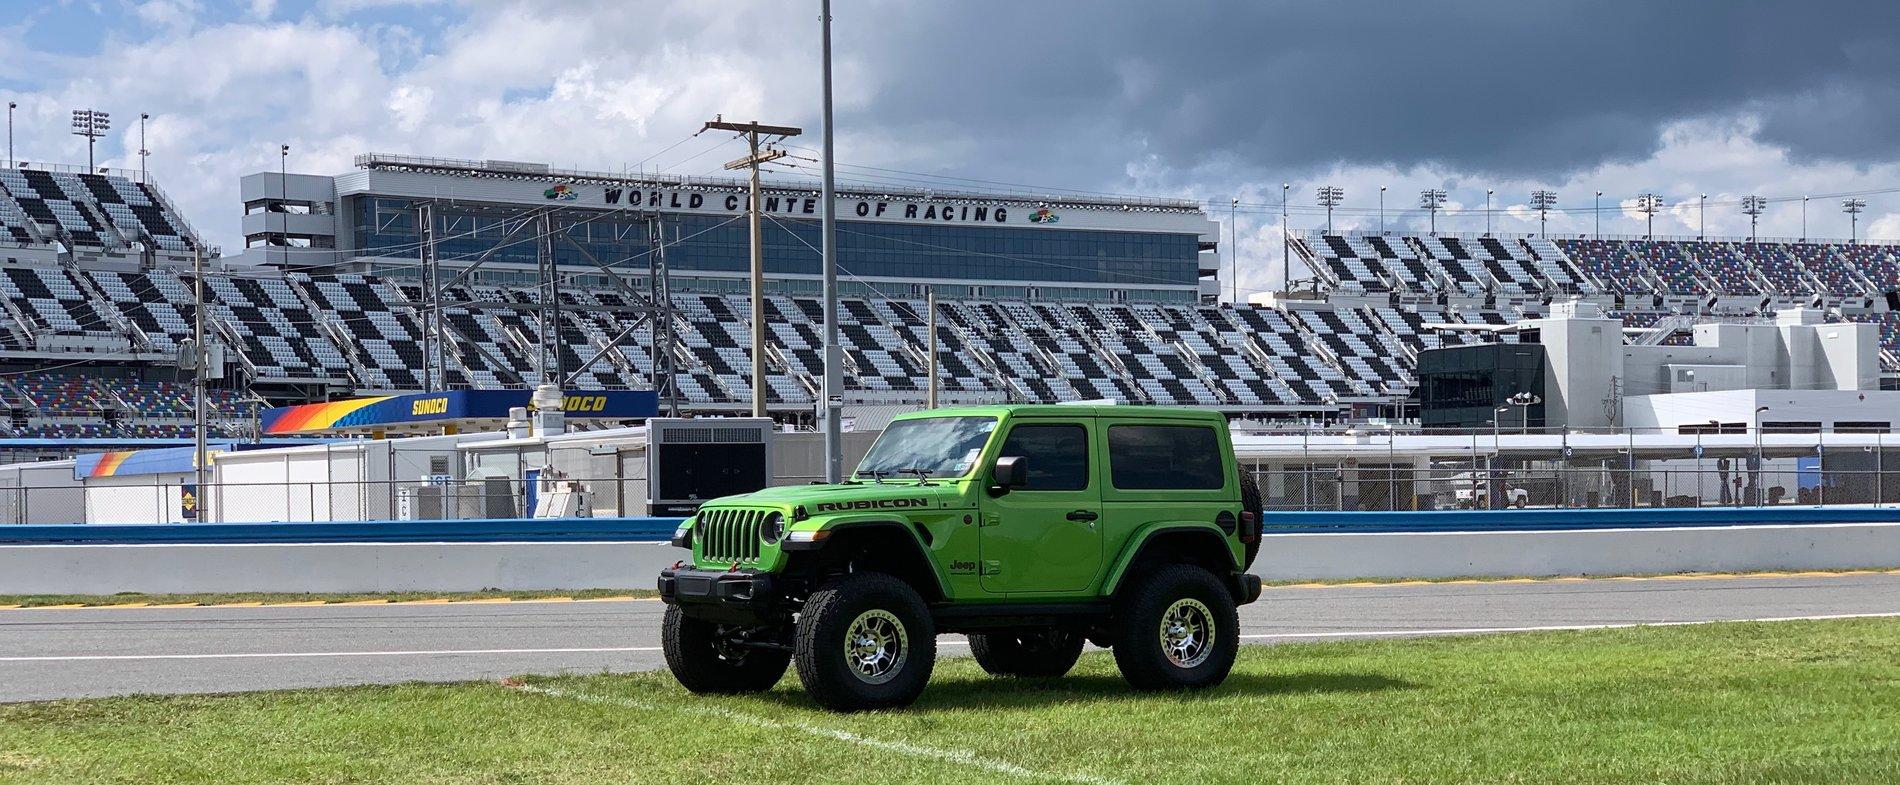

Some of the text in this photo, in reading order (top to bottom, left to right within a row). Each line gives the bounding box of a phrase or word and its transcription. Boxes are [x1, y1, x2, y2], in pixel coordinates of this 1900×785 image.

[605, 189, 1007, 223] WORLD CNTE OF RACING
[412, 397, 448, 415] SUNOCO
[527, 396, 607, 412] NOCO
[816, 498, 928, 511] RUBICON
[949, 560, 976, 571] Jeep
